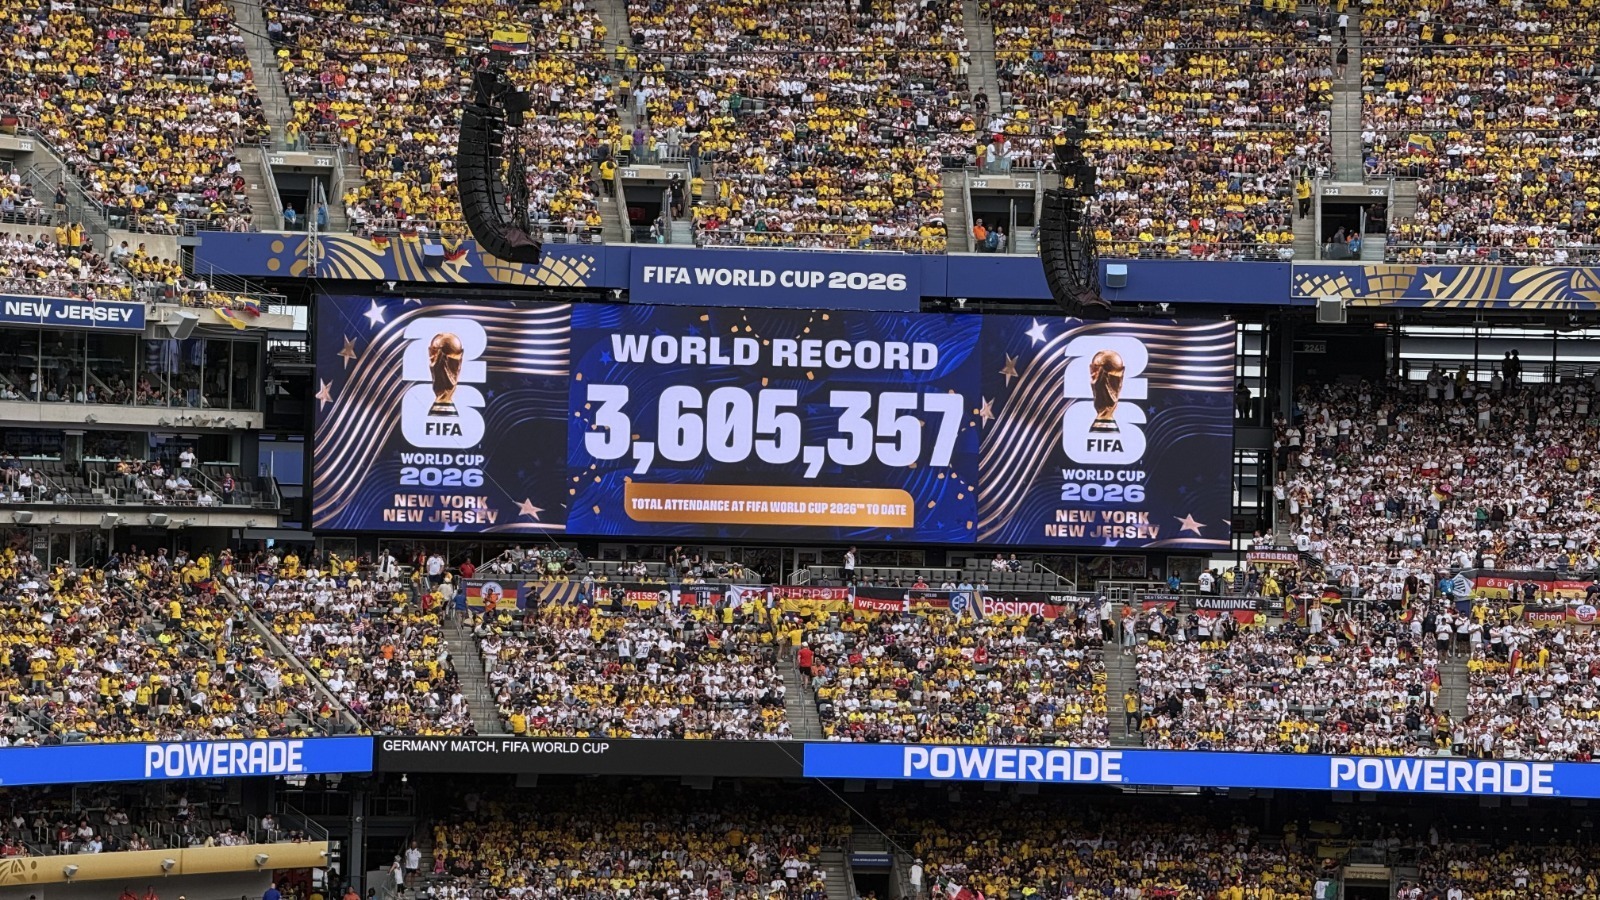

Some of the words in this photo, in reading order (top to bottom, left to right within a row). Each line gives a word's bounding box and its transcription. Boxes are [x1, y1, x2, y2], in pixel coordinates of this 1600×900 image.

[643, 265, 691, 285] FIFA
[694, 267, 776, 287] WORLD
[780, 270, 825, 288] CUP
[828, 272, 907, 291] 2026
[5, 301, 52, 317] NEW
[55, 305, 133, 322] JERSEY
[611, 334, 759, 366] WORLD
[772, 338, 939, 370] RECORD
[425, 422, 462, 436] FIFA
[585, 384, 964, 478] 3,605,357
[1086, 438, 1124, 453] FIFA
[401, 452, 453, 465] WORLD
[455, 454, 485, 466] CUP
[400, 467, 484, 487] 2026
[1062, 469, 1114, 481] WORLD
[1117, 470, 1146, 481] CUP
[1061, 483, 1145, 503] 2026
[394, 494, 435, 507] NEW
[440, 495, 488, 509] YORK
[631, 498, 663, 510] TOTAL
[664, 499, 730, 512] ATTENDANCE
[731, 500, 745, 512] AT
[746, 501, 768, 513] FIFA
[770, 501, 806, 514] WORLD
[808, 502, 827, 515] CUP
[866, 503, 880, 515] TO
[881, 504, 907, 516] DATE
[383, 509, 423, 522] NEW
[428, 510, 498, 524] JERSEY
[1056, 509, 1096, 523] NEW
[1101, 511, 1150, 525] YORK
[1045, 524, 1085, 537] NEW
[1089, 525, 1160, 539] JERSEY
[1195, 599, 1257, 609] KAMMINKE
[1529, 612, 1562, 621] Richen
[383, 740, 448, 751] GERMANY
[450, 740, 499, 754] MATCH,
[502, 741, 530, 753] FIFA
[532, 742, 579, 753] WORLD
[582, 742, 609, 753] CUP
[144, 740, 304, 777] POWERADE
[903, 746, 1123, 782] POWERADE
[1330, 758, 1554, 794] POWERADE
